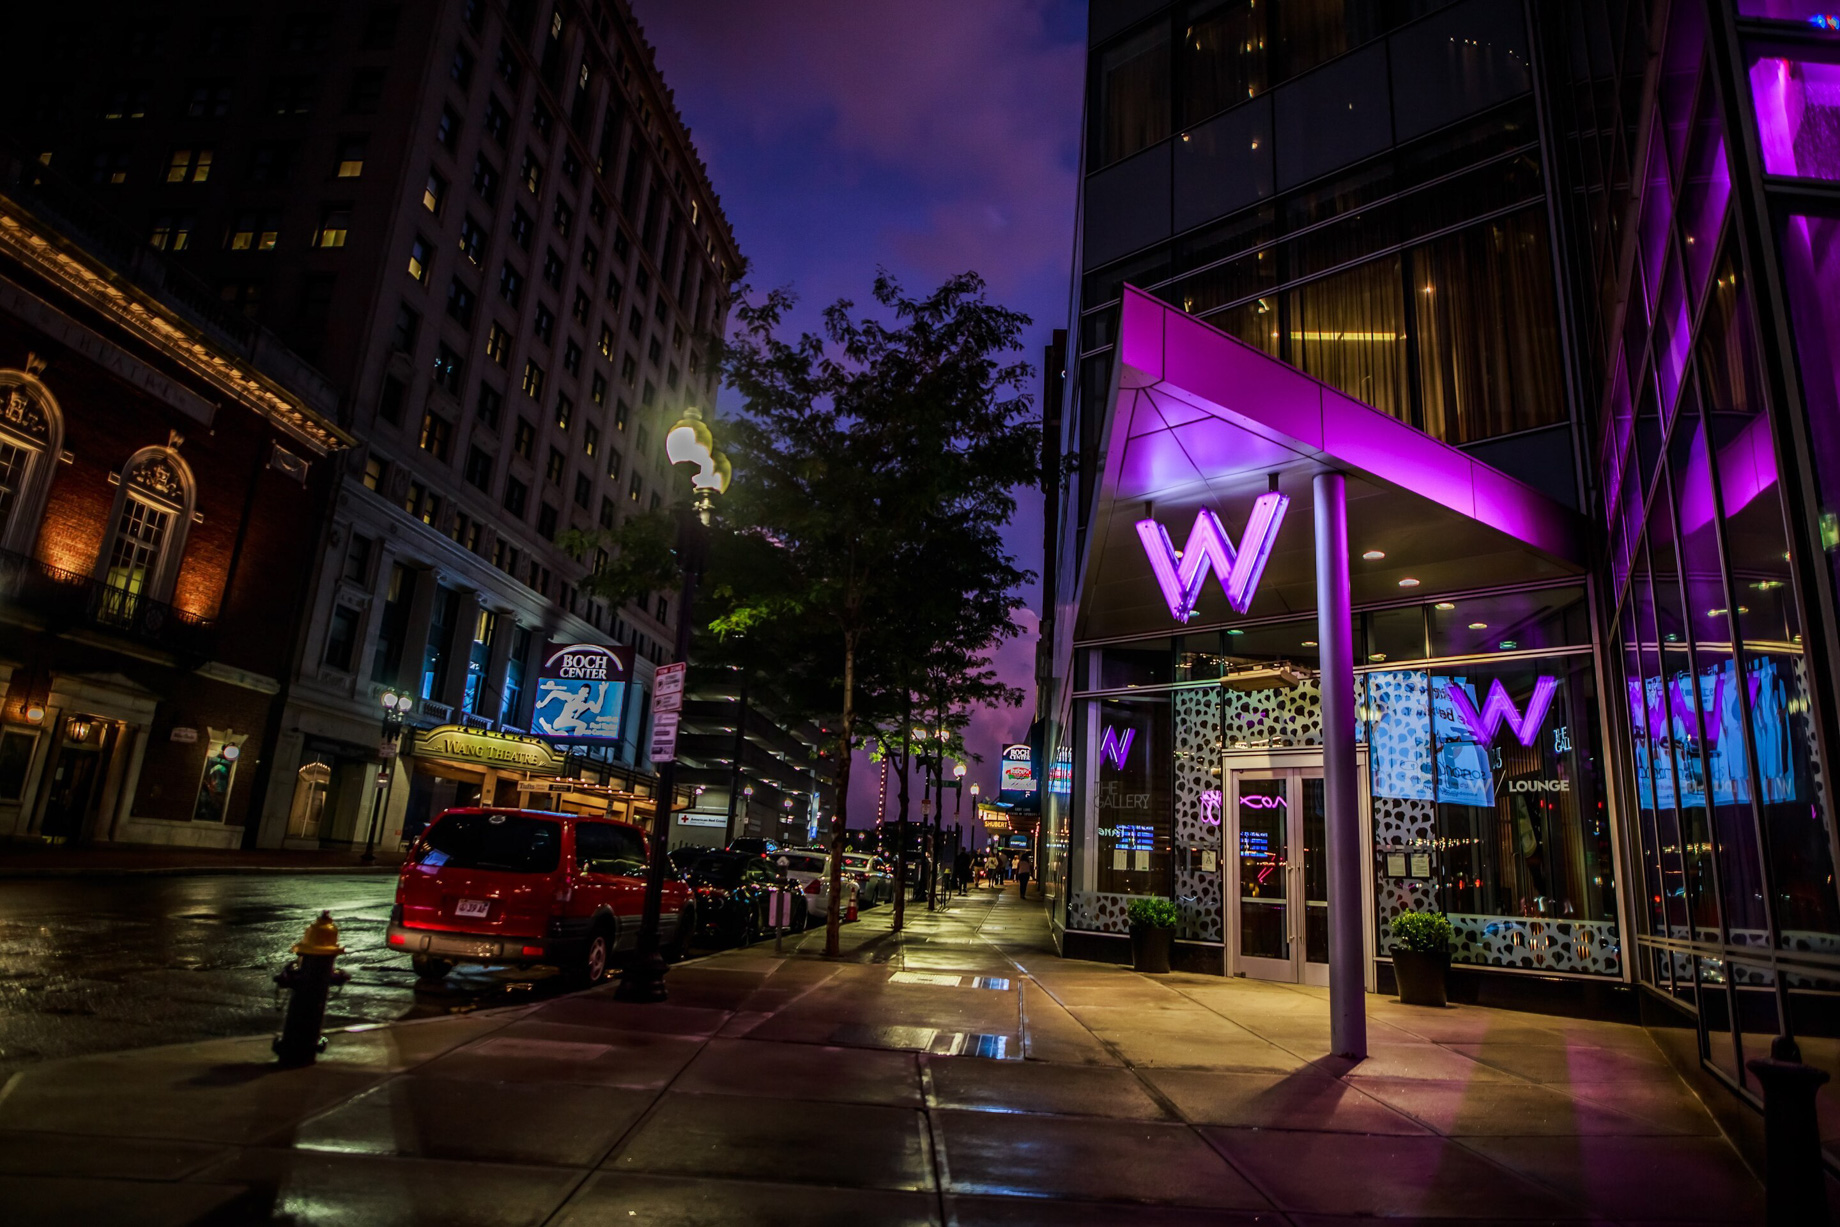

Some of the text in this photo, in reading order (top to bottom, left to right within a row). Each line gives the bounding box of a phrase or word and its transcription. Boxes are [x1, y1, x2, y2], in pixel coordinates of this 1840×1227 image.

[1135, 491, 1291, 624] W
[561, 654, 608, 669] BOCH
[559, 667, 607, 680] CENTER
[444, 739, 538, 765] WANG THEATRE
[519, 782, 535, 790] Tufts
[1094, 780, 1119, 795] THE
[1508, 779, 1570, 792] LOUNGE
[1094, 794, 1150, 809] GALLERY
[984, 820, 1008, 828] SHUBERT
